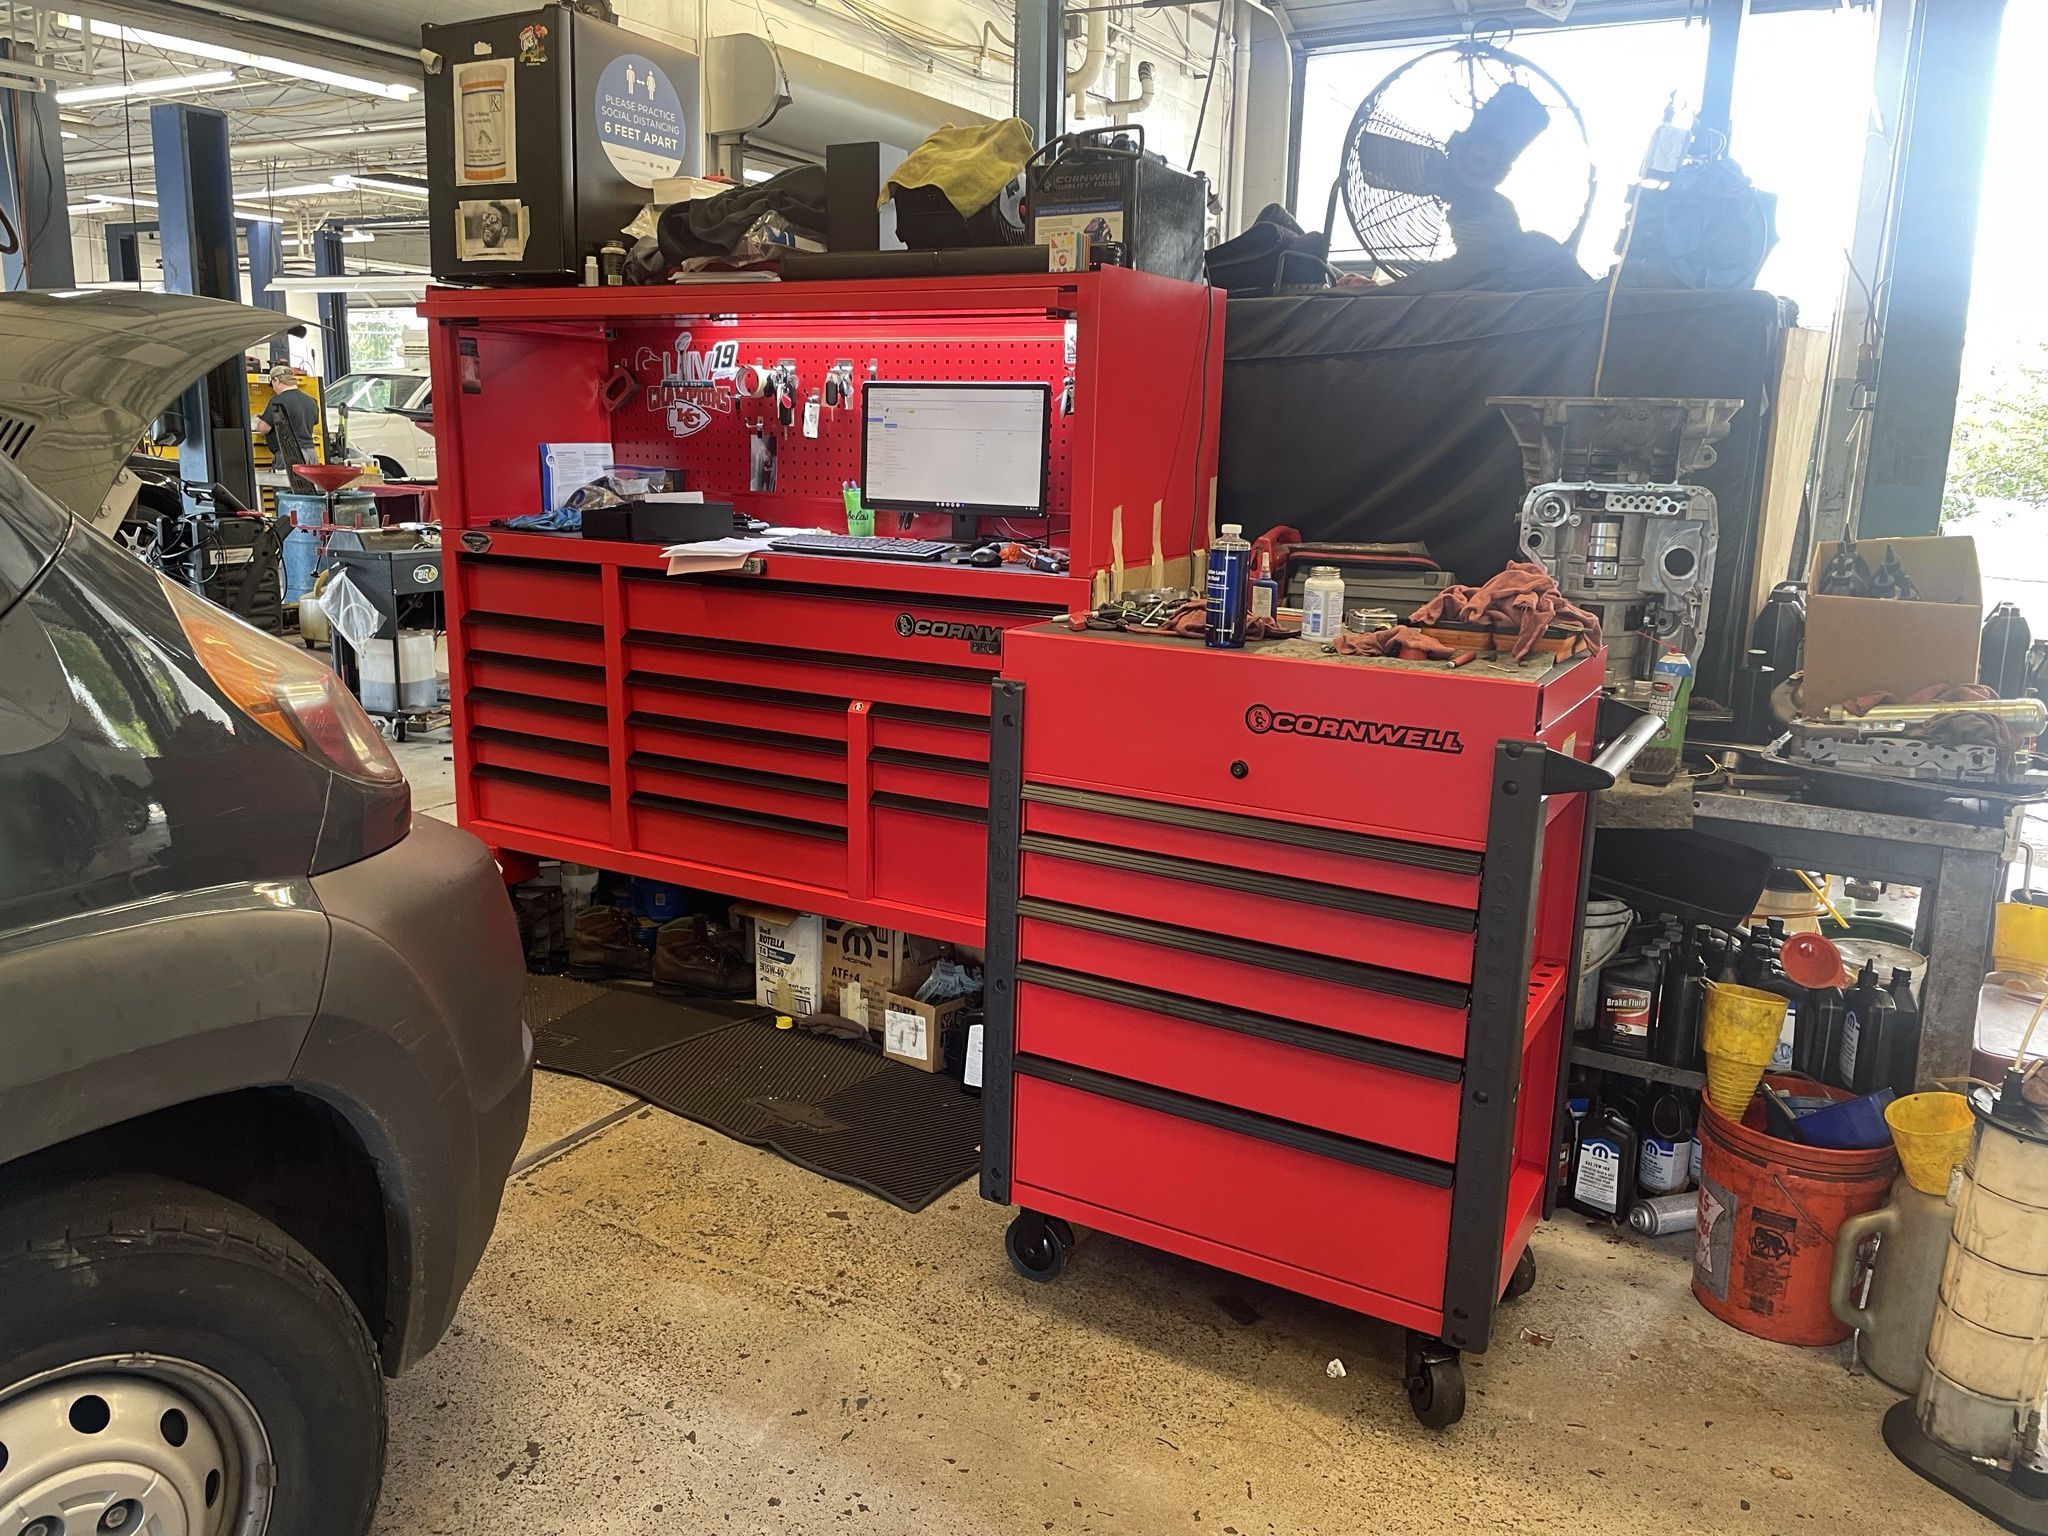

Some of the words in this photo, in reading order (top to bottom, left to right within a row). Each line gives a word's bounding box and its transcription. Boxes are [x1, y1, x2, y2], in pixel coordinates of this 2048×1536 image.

[605, 94, 636, 112] PLEASE
[637, 103, 676, 122] PRACTICE
[601, 105, 631, 122] SOCIAL
[633, 114, 680, 135] DISTANCING
[604, 121, 612, 133] 6
[614, 123, 641, 141] FEET
[643, 131, 678, 151] APART
[1054, 182, 1091, 190] QUALITY
[1055, 172, 1120, 184] CORNWELL
[713, 344, 736, 369] 19
[677, 408, 701, 428] KC
[1271, 713, 1463, 752] CORNWELL
[759, 933, 785, 950] ROTELLA
[764, 964, 784, 977] 15W-40
[842, 956, 872, 968] MOPAR
[831, 966, 860, 982] ATF+4
[1607, 998, 1627, 1006] Brake
[1628, 998, 1646, 1007] Fluid
